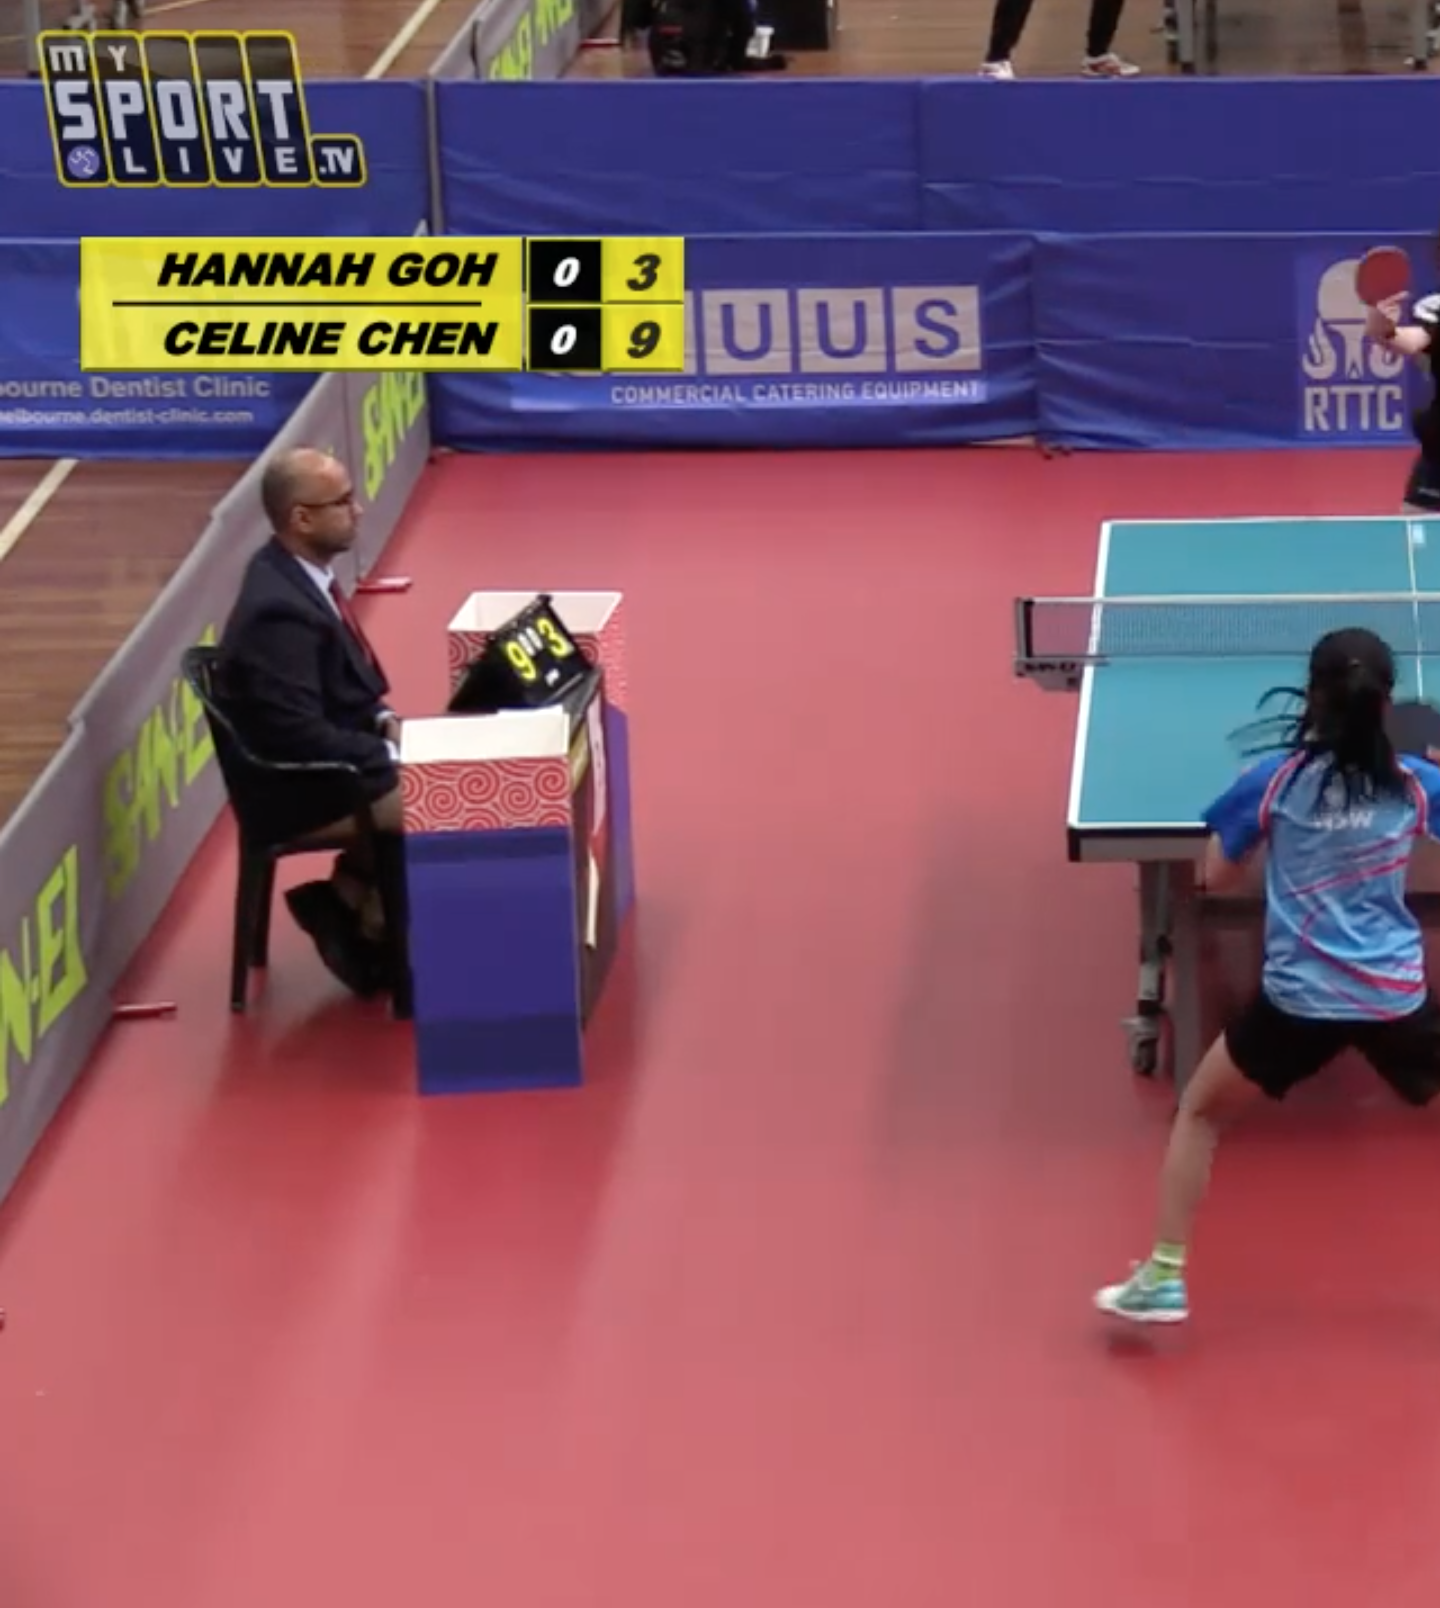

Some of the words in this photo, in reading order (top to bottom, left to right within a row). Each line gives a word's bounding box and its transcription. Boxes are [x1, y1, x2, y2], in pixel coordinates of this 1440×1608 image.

[89, 376, 187, 398] Dentist
[193, 375, 271, 398] Clinic
[611, 384, 744, 405] COMMERCIAL
[752, 382, 857, 402] CATERING
[862, 380, 979, 400] EQUIPMENT
[1304, 385, 1403, 431] RTTC
[506, 640, 537, 681] 9
[537, 617, 575, 658] 3
